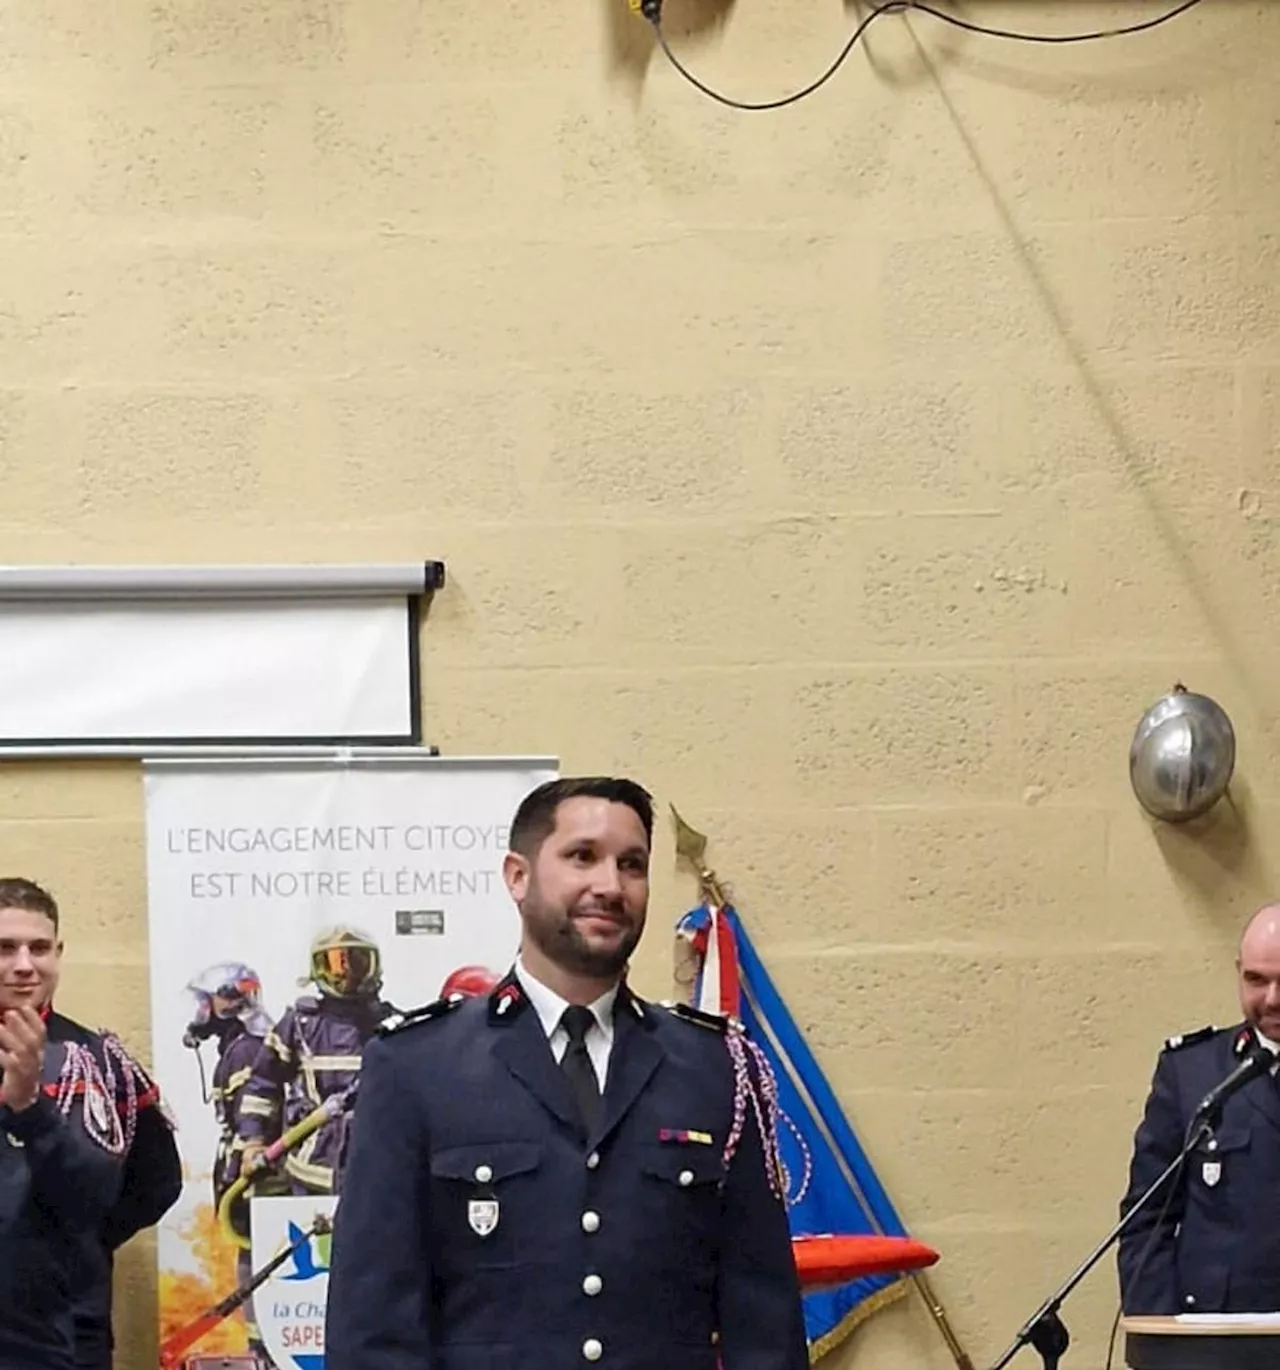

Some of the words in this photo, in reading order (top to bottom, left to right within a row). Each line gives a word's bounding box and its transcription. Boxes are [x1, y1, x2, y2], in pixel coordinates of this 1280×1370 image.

[167, 825, 395, 853] L'ENGAGEMENT
[190, 872, 243, 899] EST
[251, 870, 351, 898] NOTRE
[362, 865, 497, 897] ÉLÉMENT
[273, 1302, 290, 1318] la
[282, 1326, 324, 1347] SAPE
